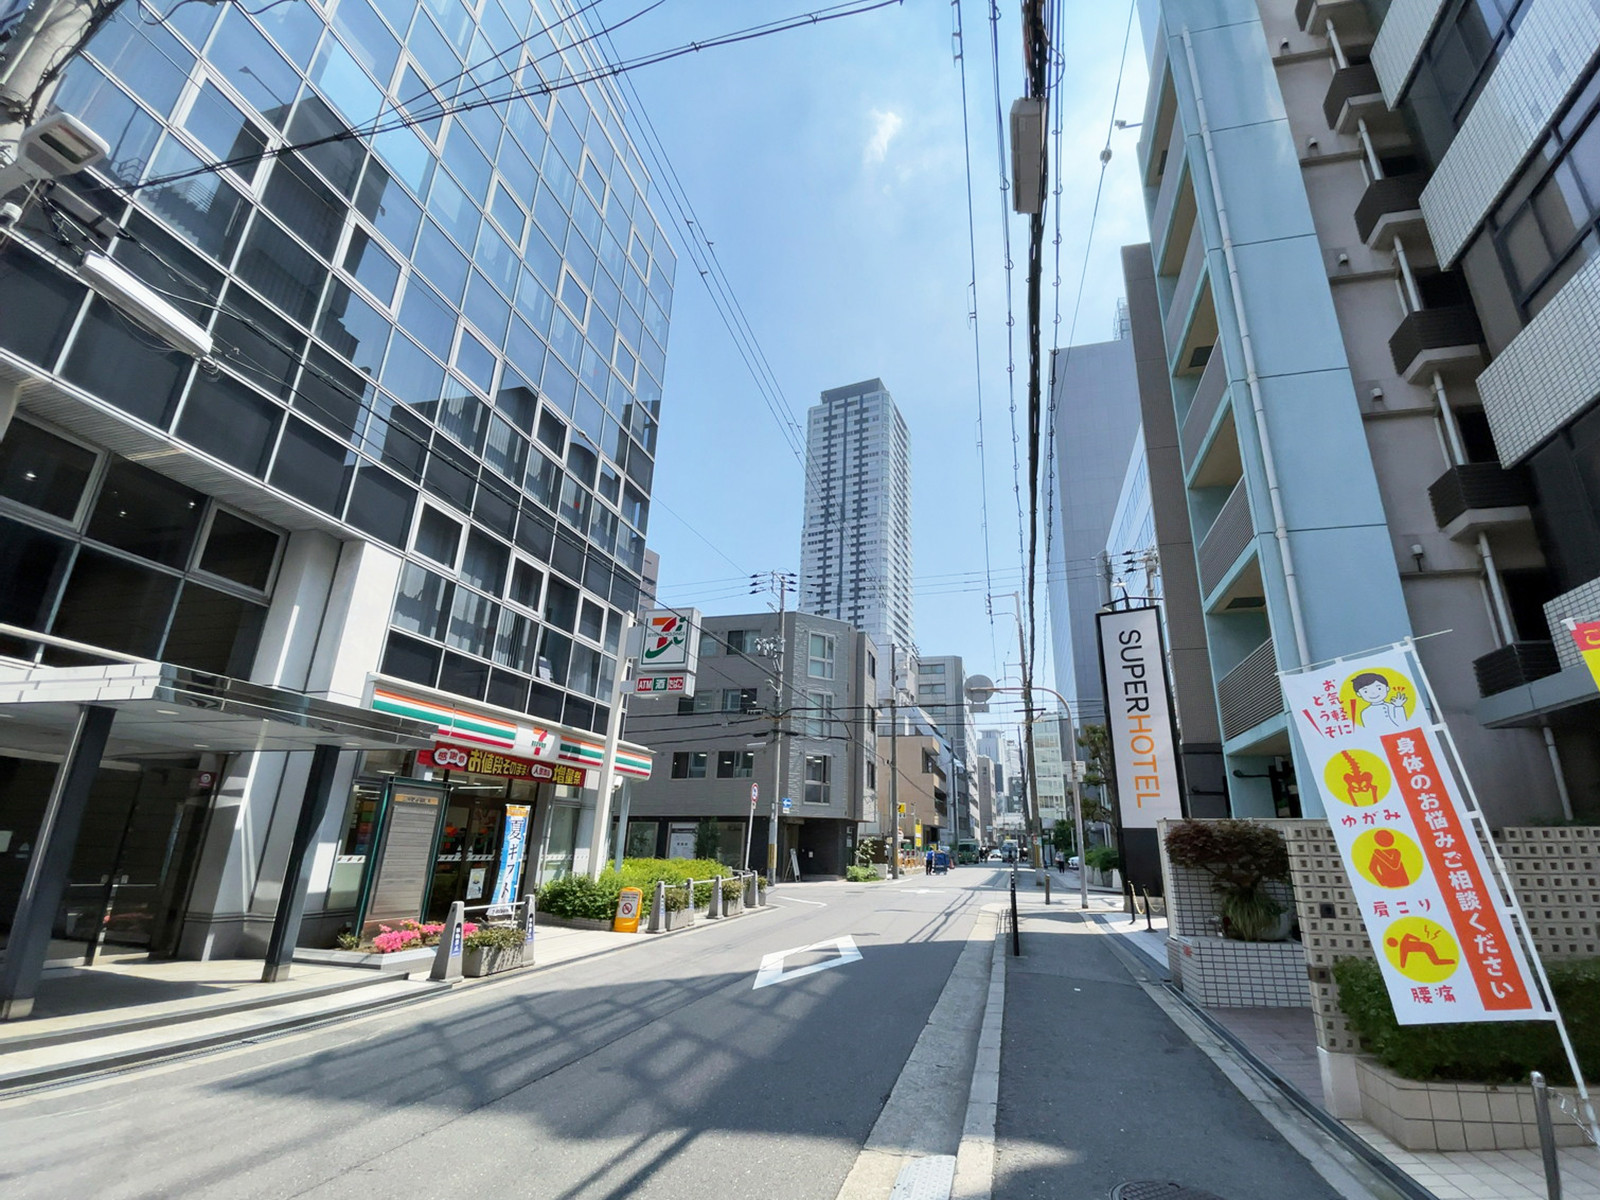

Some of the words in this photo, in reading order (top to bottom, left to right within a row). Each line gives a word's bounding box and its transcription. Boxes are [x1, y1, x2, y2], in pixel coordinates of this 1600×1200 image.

[638, 680, 652, 690] ATM
[655, 679, 666, 690] 酒
[1312, 694, 1336, 739] どうぞ
[1322, 679, 1353, 736] お気軽に
[552, 764, 582, 785] 増量祭
[1342, 809, 1401, 828] ゆがみ
[501, 819, 522, 899] 夏ギフト
[1397, 737, 1514, 999] 身体のお悩みご相談ください
[1373, 898, 1431, 918] 肩こり
[1411, 984, 1456, 1004] 腰痛
